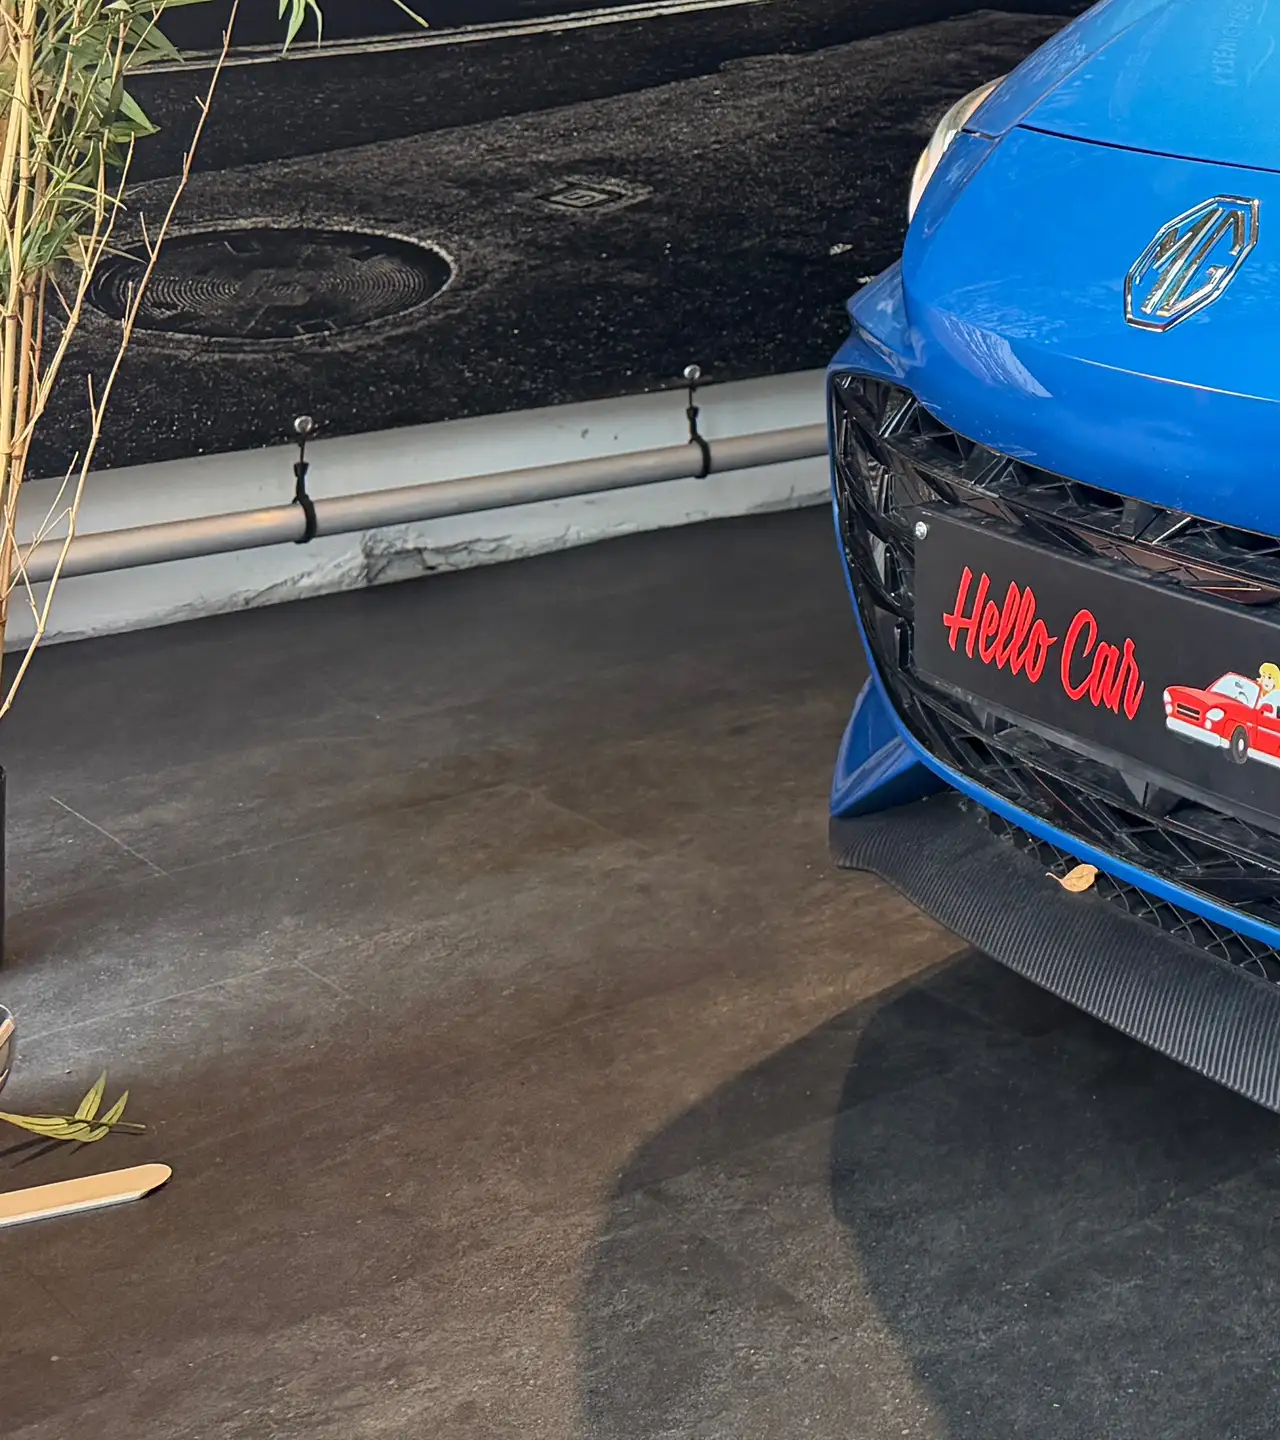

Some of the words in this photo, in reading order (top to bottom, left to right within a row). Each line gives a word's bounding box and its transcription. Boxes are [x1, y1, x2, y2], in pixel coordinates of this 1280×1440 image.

[1133, 207, 1246, 317] MG
[942, 566, 1058, 684] Hello
[1060, 609, 1146, 721] Car
